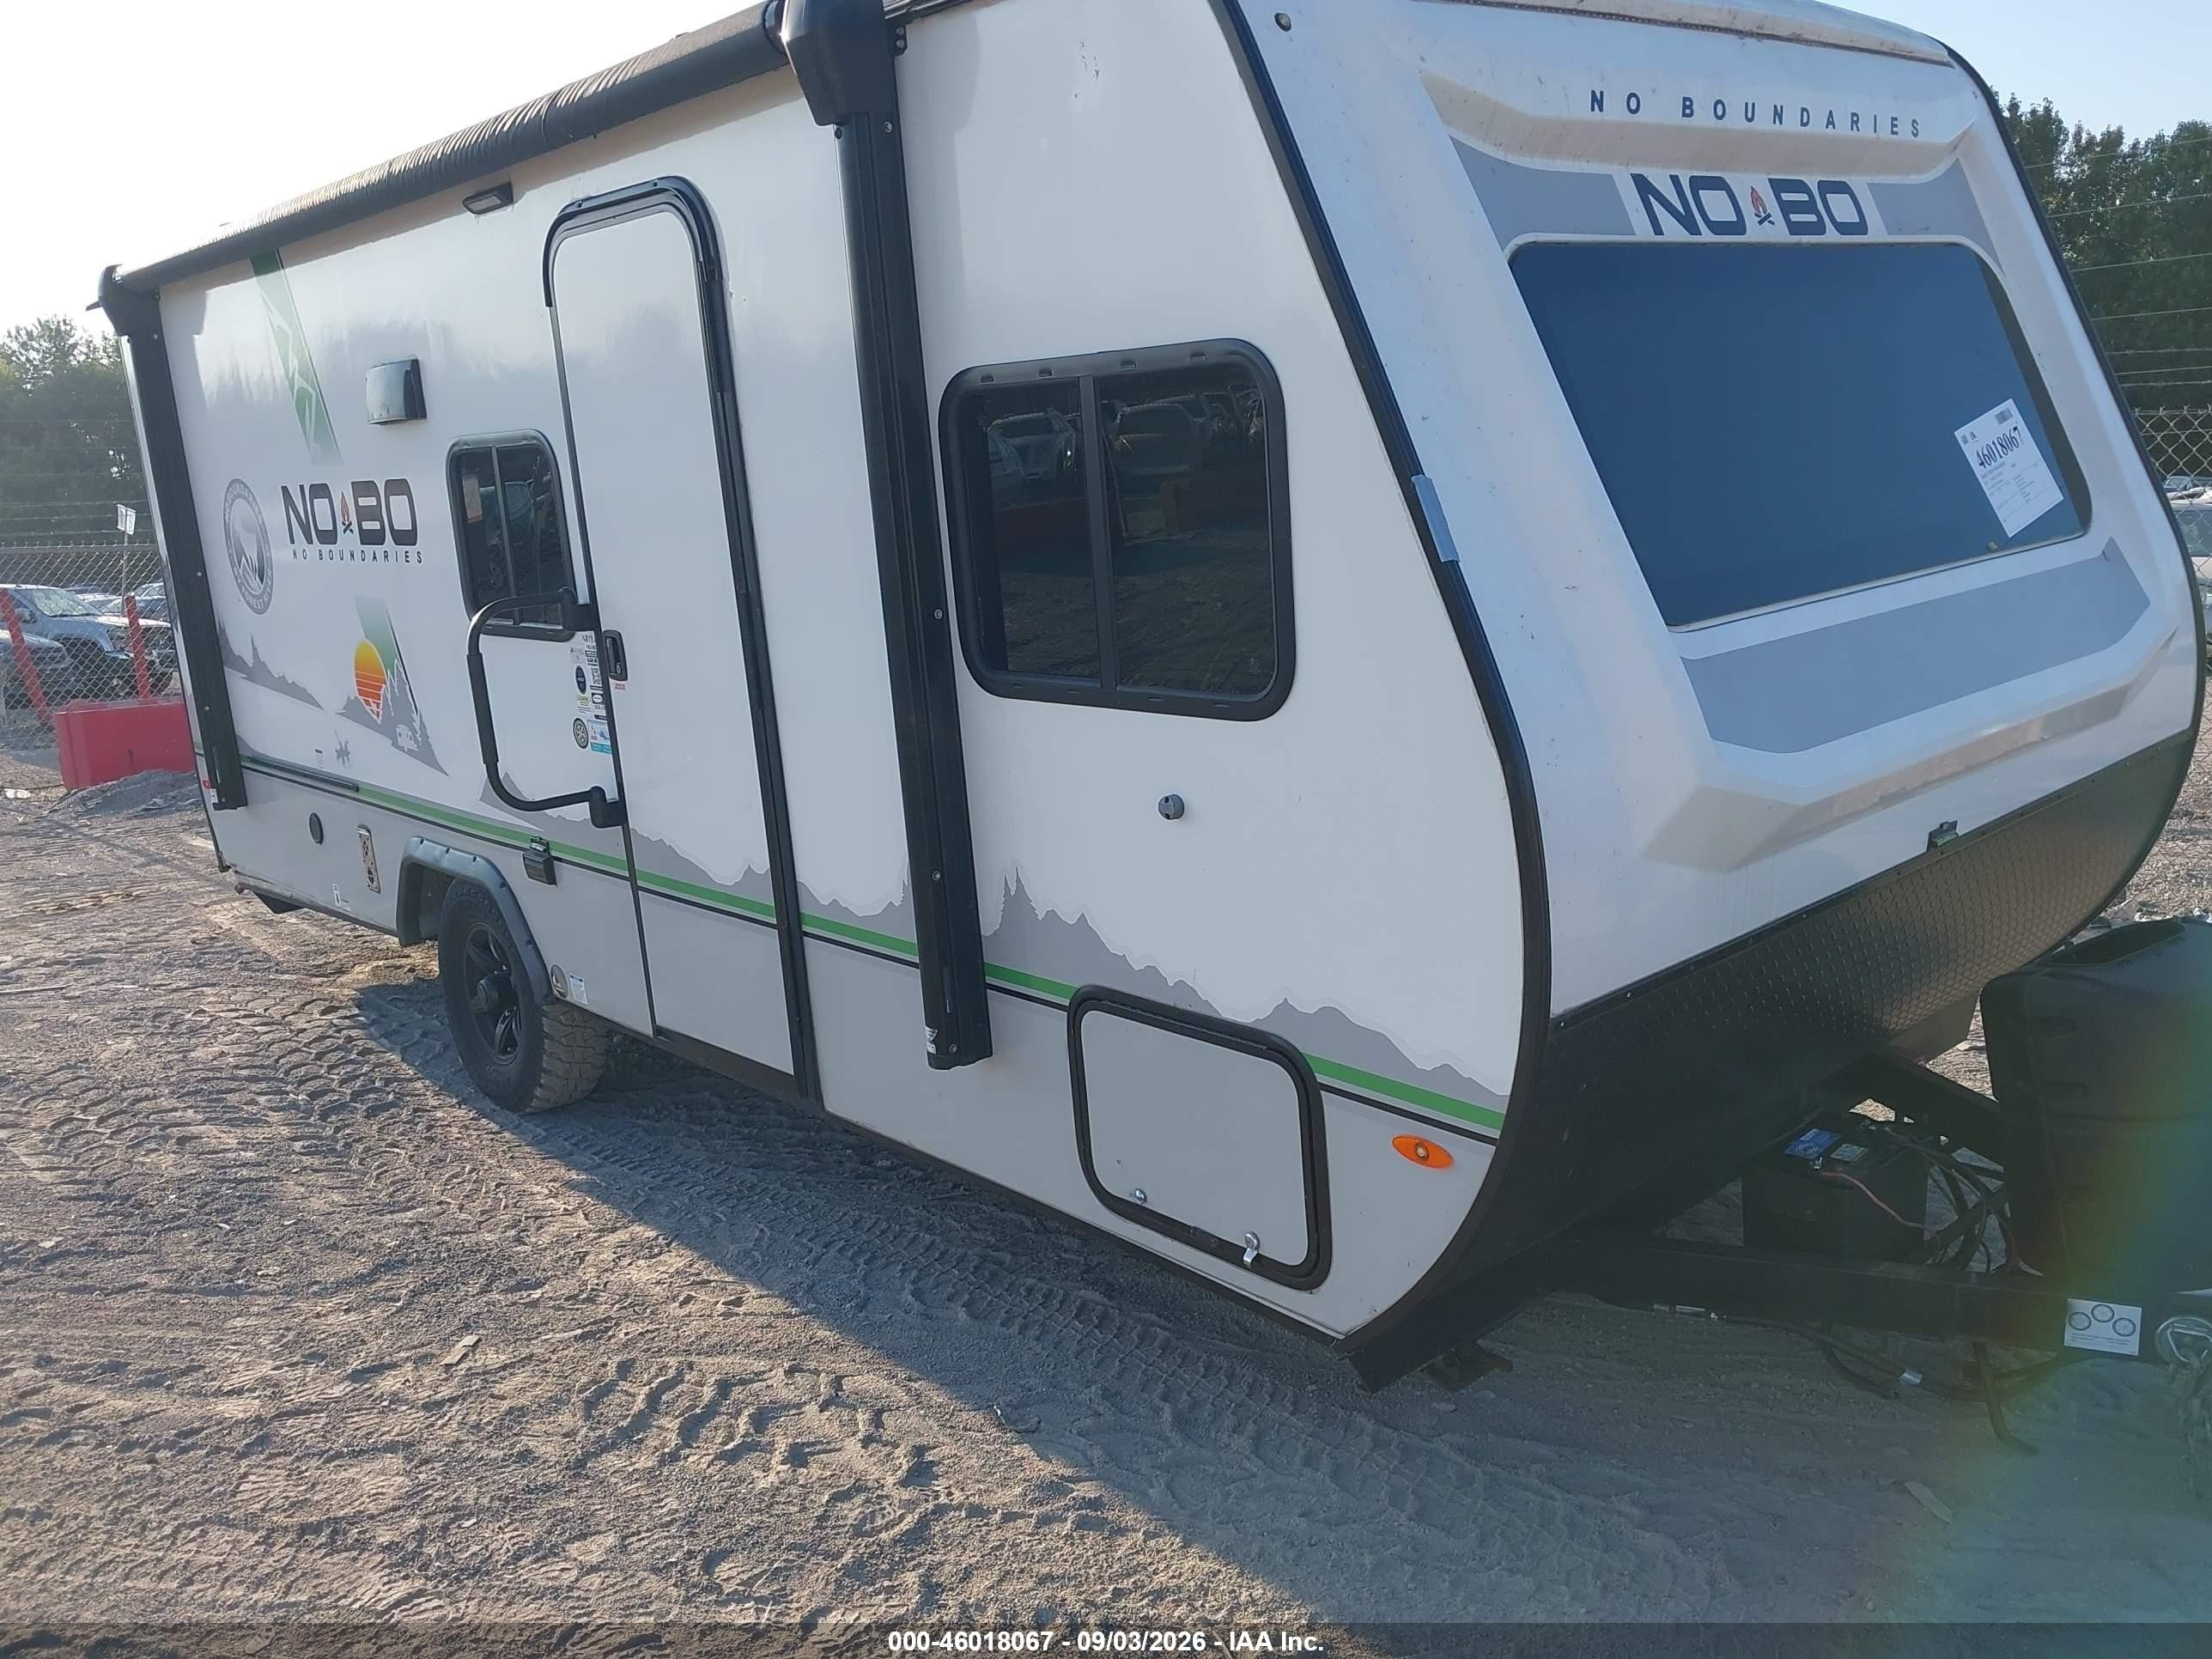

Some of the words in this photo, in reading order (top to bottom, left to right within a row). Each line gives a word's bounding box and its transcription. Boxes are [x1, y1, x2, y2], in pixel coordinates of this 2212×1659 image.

[1589, 89, 1642, 115] NO
[1680, 95, 1921, 138] BOUNDARIES
[1630, 173, 1747, 236] NO
[1767, 177, 1869, 236] BO
[1976, 425, 2025, 469] 46018067
[281, 483, 338, 545] NO
[350, 477, 418, 546] BO
[292, 549, 307, 560] NO
[318, 549, 422, 563] BOUNDARIES
